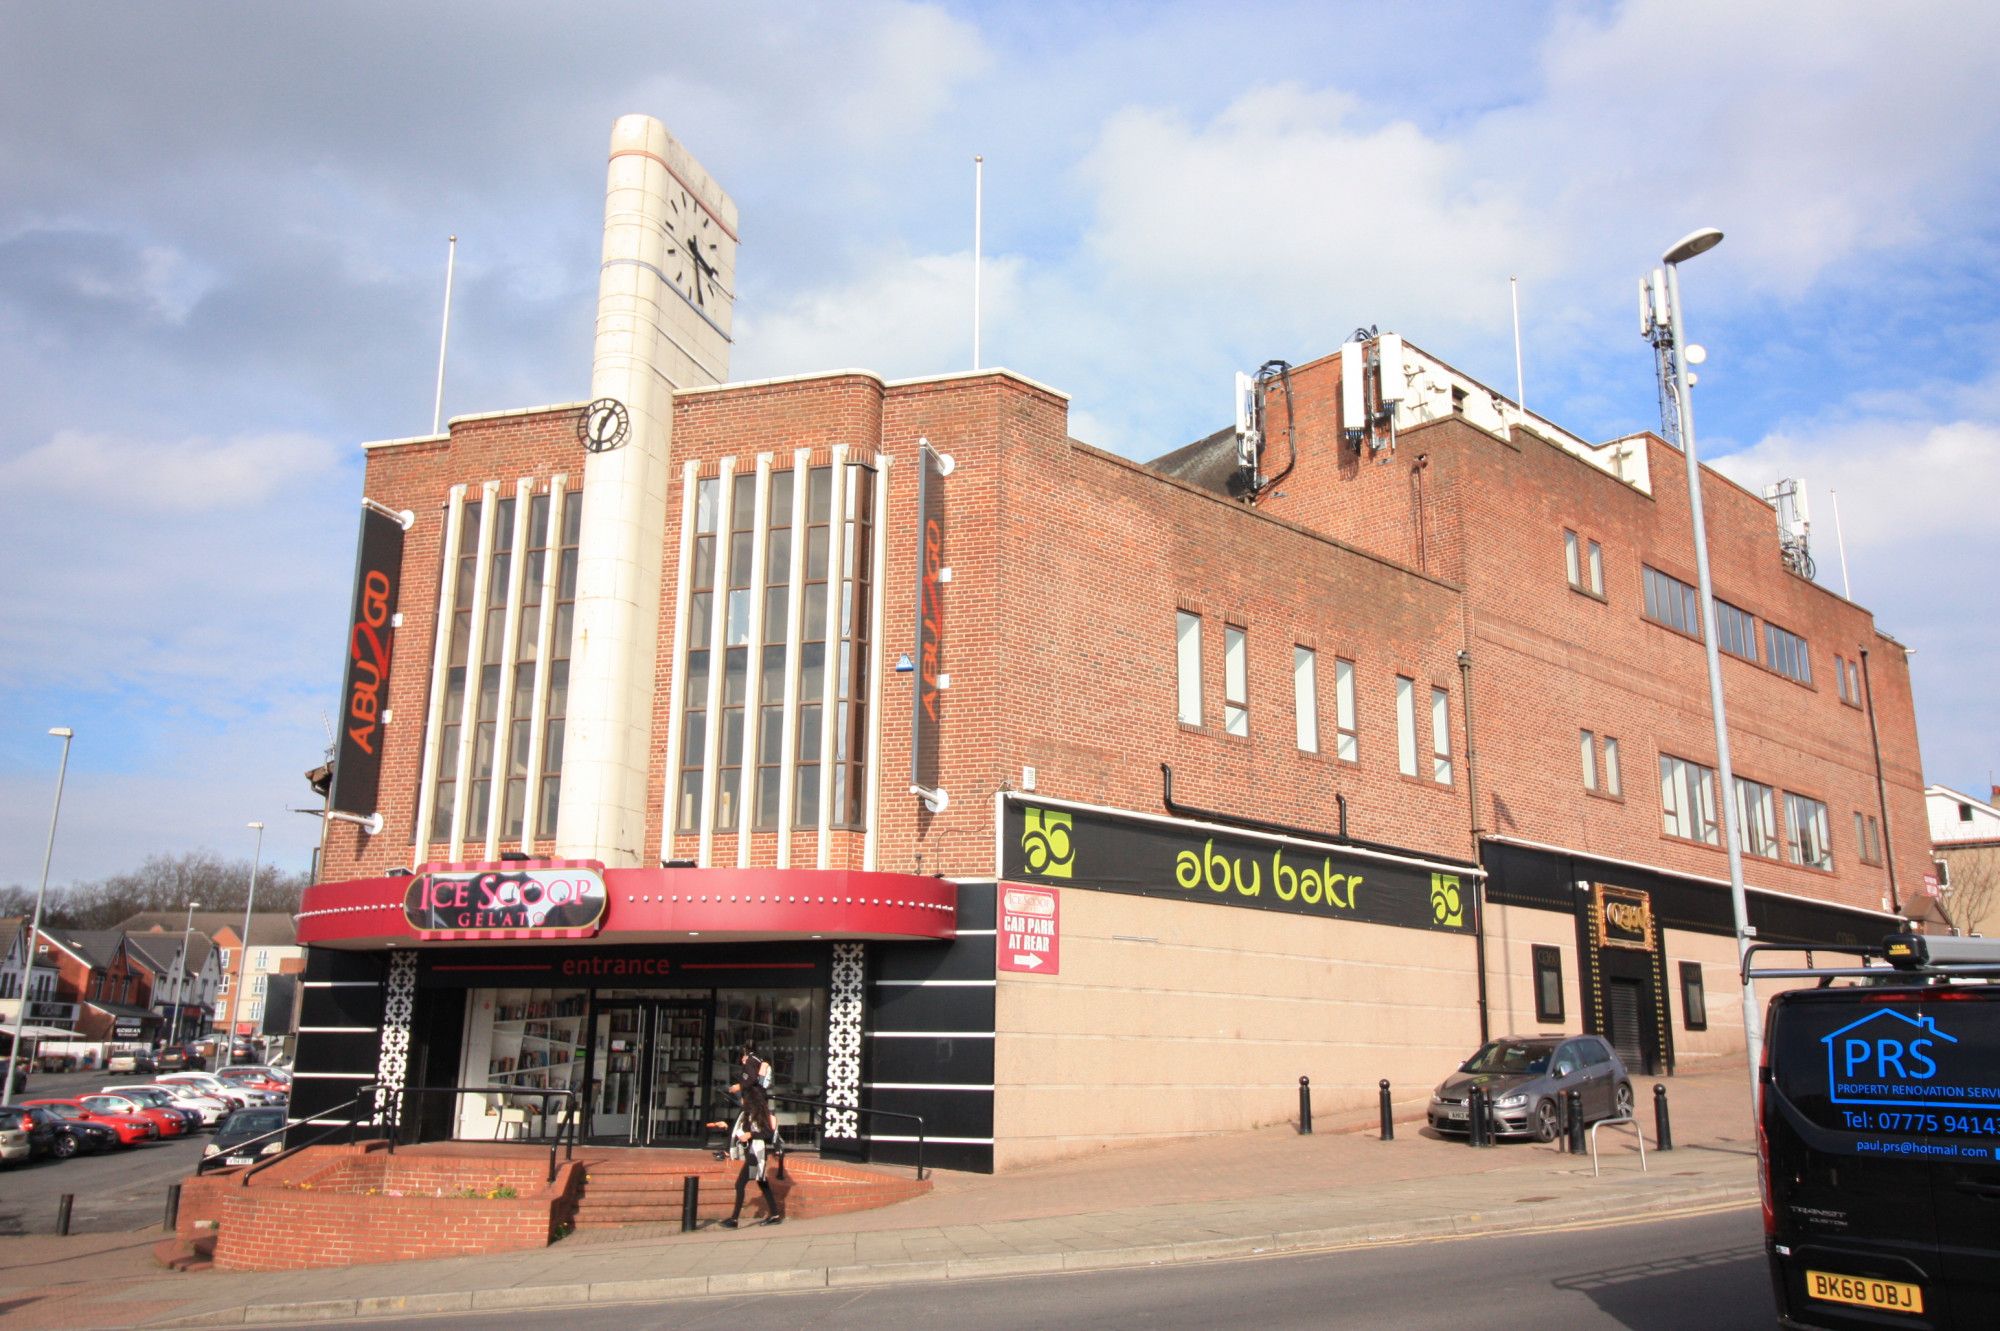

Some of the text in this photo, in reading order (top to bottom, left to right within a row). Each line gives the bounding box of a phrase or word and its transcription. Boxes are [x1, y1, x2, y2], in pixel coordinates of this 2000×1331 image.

[350, 570, 391, 754] ABU2GO
[1175, 838, 1363, 909] abu bakr
[419, 874, 592, 910] ICE SCOOP
[458, 911, 545, 927] GELATO
[1004, 915, 1055, 935] CAR PARK
[1009, 934, 1050, 952] AT REAR
[562, 956, 672, 976] entrance
[1845, 1038, 1937, 1079] PRS
[1837, 1083, 1889, 1095] PROPERTY
[1892, 1085, 1964, 1097] RENOVATION
[1842, 1111, 1873, 1129] Tel:
[1878, 1112, 1938, 1132] 07775
[1815, 1275, 1912, 1307] BK68 OBJ
